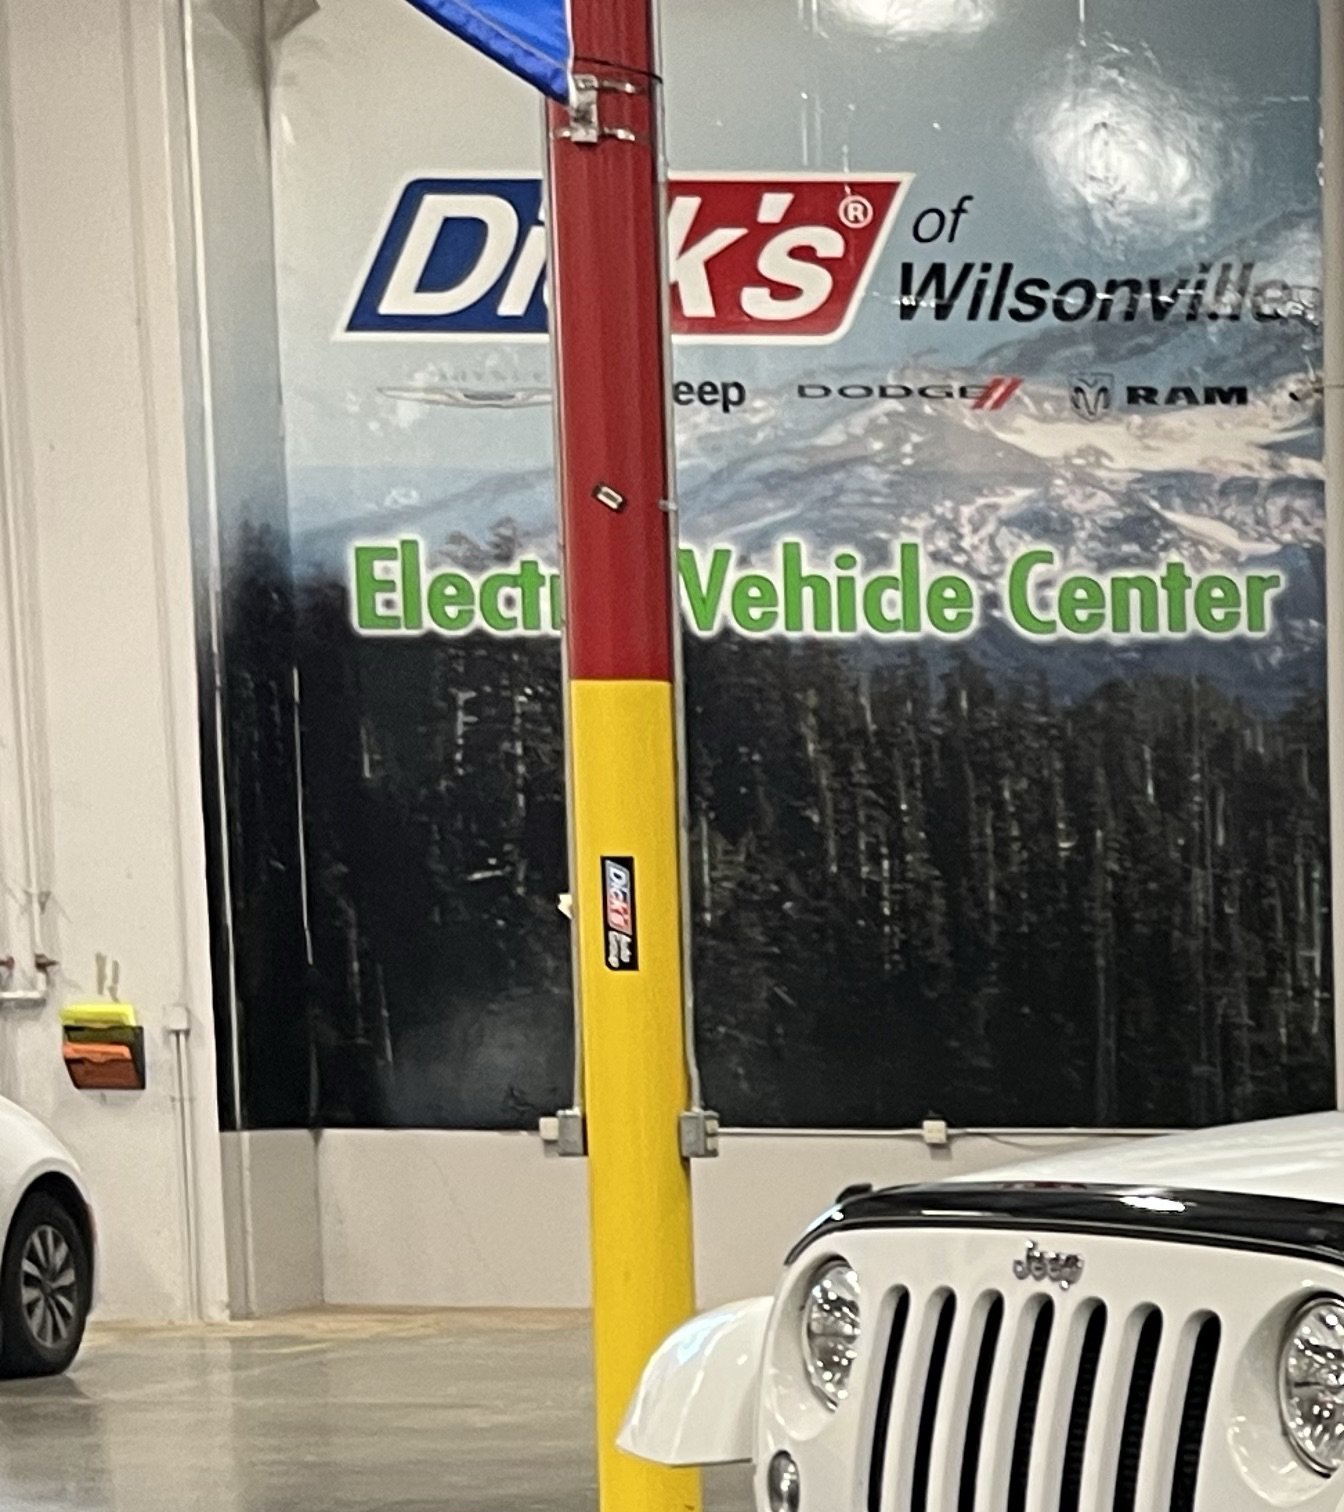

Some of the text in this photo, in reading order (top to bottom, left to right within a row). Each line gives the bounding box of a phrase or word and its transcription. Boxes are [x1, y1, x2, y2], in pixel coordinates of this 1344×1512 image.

[912, 194, 974, 244] of
[378, 192, 845, 321] Dik's
[899, 260, 1297, 324] Wilsonville
[673, 380, 746, 414] eep
[797, 384, 992, 400] DODGE
[1125, 385, 1249, 406] RAM
[353, 538, 1280, 635] Elect Vehicle Center
[1013, 1239, 1084, 1292] Jeep
